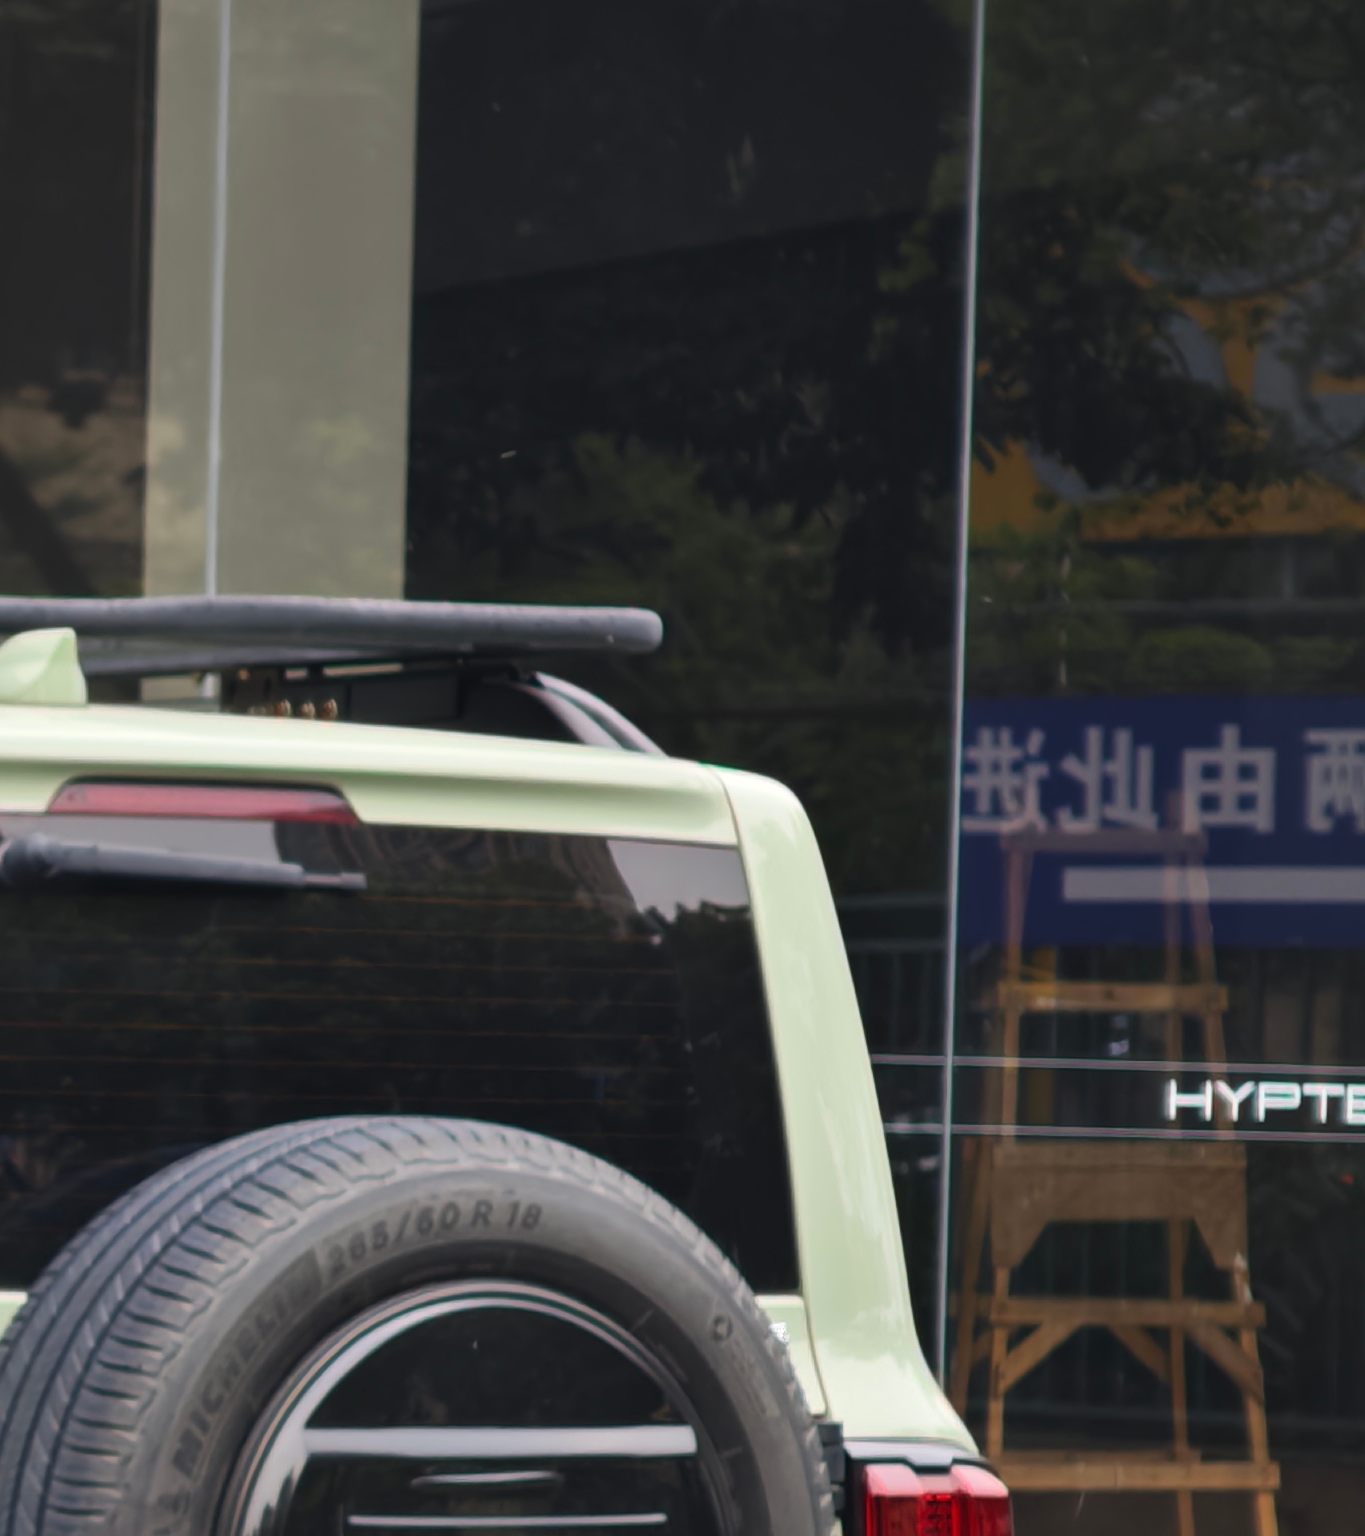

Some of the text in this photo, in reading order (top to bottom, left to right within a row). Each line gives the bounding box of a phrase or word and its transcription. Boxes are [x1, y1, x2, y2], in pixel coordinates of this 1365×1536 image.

[325, 1198, 545, 1274] 265/60 R 18
